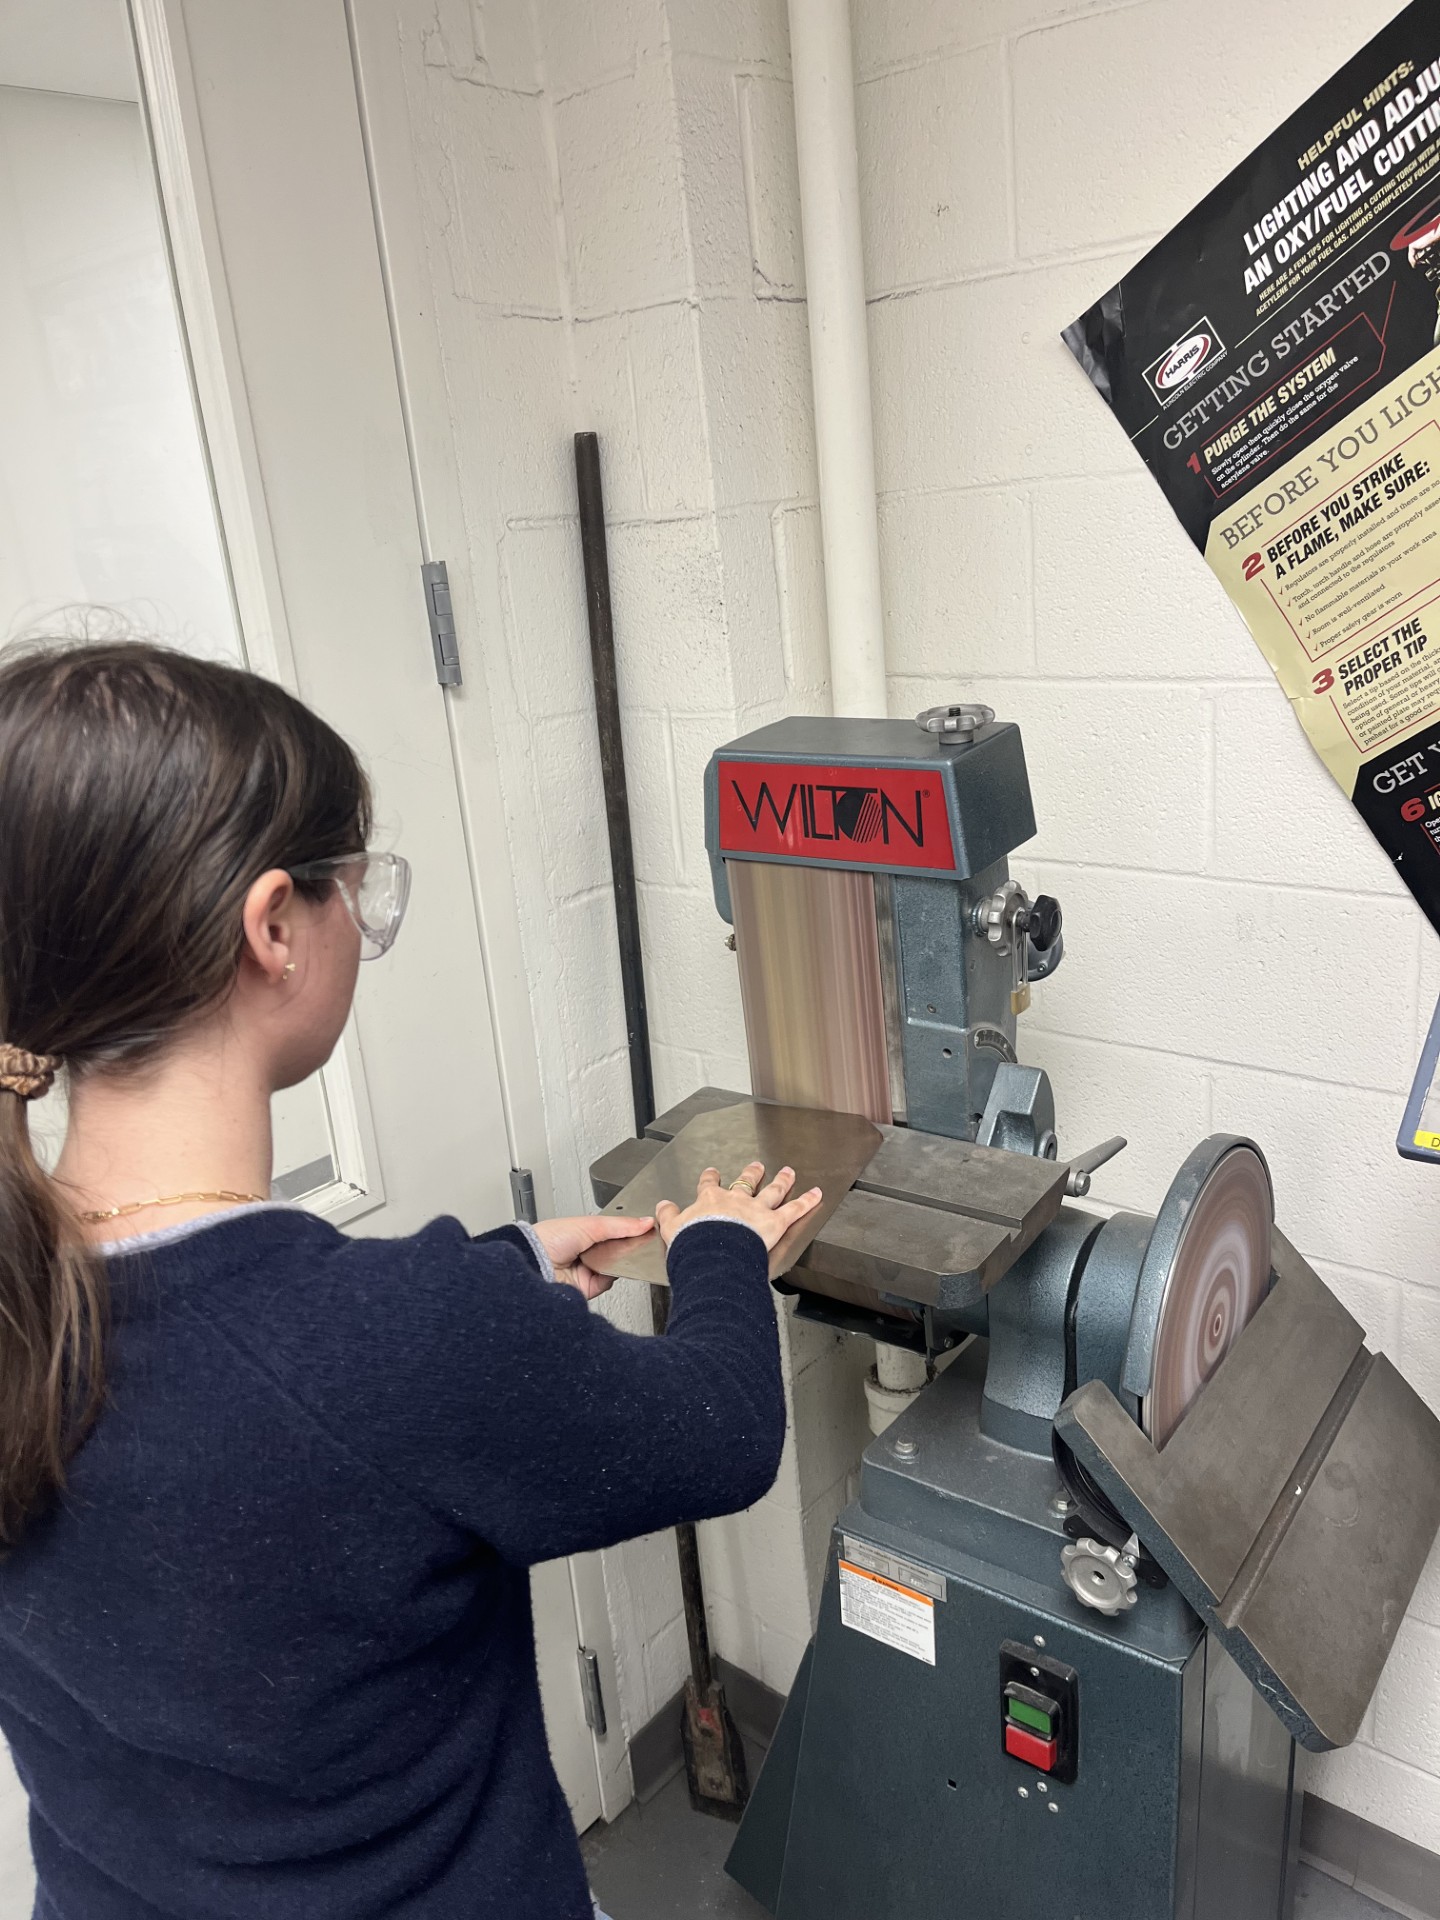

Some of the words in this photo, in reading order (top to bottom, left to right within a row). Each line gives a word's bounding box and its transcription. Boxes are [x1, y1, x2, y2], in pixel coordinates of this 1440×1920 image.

[1297, 108, 1362, 170] HELPFUL
[1362, 60, 1414, 110] HINTS:
[1243, 161, 1335, 255] LIGHTING
[1336, 119, 1380, 174] AND
[1384, 59, 1440, 131] ADJU
[1243, 252, 1273, 294] AN
[1274, 168, 1373, 263] OXY/FUEL
[1256, 283, 1288, 316] ACETYLENE
[1288, 273, 1300, 287] FOR
[1300, 258, 1317, 276] YOUR
[1317, 245, 1334, 262] FUEL
[1333, 233, 1349, 248] GAS.
[1349, 210, 1373, 236] ALWAYS
[1373, 175, 1413, 214] COMPLETELY
[1258, 283, 1275, 301] HERE
[1275, 271, 1288, 287] ARE
[1288, 267, 1294, 276] A
[1293, 254, 1306, 270] FEW
[1306, 242, 1321, 258] TIPS
[1321, 231, 1335, 246] FOR
[1334, 206, 1363, 235] LIGHTING
[1363, 202, 1369, 210] A
[1369, 178, 1396, 205] CUTTING
[1395, 159, 1417, 181] TORCH
[1417, 143, 1435, 163] WITH
[1163, 349, 1269, 449] GETTING
[1271, 251, 1390, 359] STARTED
[1164, 344, 1199, 378] HARRIS
[1165, 388, 1184, 407] LINCOLN
[1183, 369, 1206, 391] ELECTRIC
[1205, 350, 1227, 371] COMPANY
[1203, 418, 1249, 464] PURGE
[1247, 395, 1277, 426] THE
[1277, 346, 1336, 403] SYSTEM
[1211, 456, 1232, 474] Slowly
[1232, 444, 1248, 458] open
[1247, 432, 1262, 446] then
[1262, 413, 1285, 434] quickly
[1285, 400, 1303, 415] close
[1302, 391, 1314, 401] the
[1314, 371, 1339, 392] oxygen
[1338, 356, 1358, 372] valve
[1216, 473, 1225, 481] on
[1224, 465, 1235, 474] the
[1235, 444, 1262, 466] cylinder.
[1261, 430, 1279, 444] Then
[1278, 422, 1288, 431] do
[1287, 414, 1299, 424] the
[1299, 400, 1317, 415] same
[1316, 390, 1327, 401] for
[1326, 382, 1338, 393] the
[1186, 452, 1200, 473] 1
[1219, 465, 1319, 549] BEFORE
[1316, 417, 1378, 472] YOU
[1220, 463, 1250, 488] acetylene
[1249, 449, 1269, 464] valve.
[1266, 514, 1320, 563] BEFORE
[1319, 492, 1350, 522] YOU
[1352, 452, 1405, 500] STRIKE
[1275, 562, 1286, 579] A
[1286, 526, 1339, 570] FLAME,
[1338, 491, 1382, 532] MAKE
[1384, 460, 1430, 500] SURE:
[1284, 565, 1318, 590] Regulators
[1318, 558, 1329, 567] are
[1328, 538, 1356, 561] properly
[1356, 516, 1386, 540] installed
[1386, 506, 1399, 520] and
[1399, 495, 1418, 510] there
[1418, 486, 1430, 496] are
[1242, 552, 1264, 581] 2
[1292, 588, 1313, 602] Torch,
[1312, 575, 1330, 588] torch
[1328, 560, 1352, 577] handle
[1352, 549, 1365, 561] and
[1364, 539, 1381, 552] hose
[1381, 531, 1393, 541] are
[1393, 509, 1423, 534] properly
[1297, 597, 1310, 609] and
[1310, 575, 1343, 600] connected
[1349, 563, 1361, 572] the
[1361, 540, 1395, 566] regulators
[1304, 613, 1315, 622] No
[1314, 590, 1348, 615] flammable
[1348, 570, 1378, 592] materials
[1386, 553, 1402, 568] your
[1402, 541, 1420, 555] work
[1421, 531, 1437, 543] area
[1311, 621, 1331, 634] Room
[1337, 583, 1385, 618] well-ventilated
[1319, 630, 1341, 647] Proper
[1341, 618, 1360, 633] safety
[1361, 607, 1377, 621] gear
[1384, 591, 1403, 605] worn
[1338, 636, 1389, 679] SELECT
[1391, 616, 1422, 645] THE
[1344, 650, 1402, 696] PROPER
[1403, 634, 1427, 658] TIP
[1312, 668, 1334, 694] 3
[1342, 694, 1363, 709] Select
[1368, 685, 1378, 693] tip
[1377, 671, 1400, 688] based
[1400, 666, 1410, 674] on
[1409, 659, 1421, 668] the
[1347, 696, 1377, 716] condition
[1377, 689, 1385, 697] of
[1385, 681, 1401, 694] your
[1401, 663, 1432, 684] material,
[1349, 709, 1370, 723] being
[1370, 698, 1389, 711] used.
[1388, 686, 1409, 700] Some
[1408, 678, 1422, 688] tips
[1422, 669, 1436, 680] will
[1354, 716, 1376, 730] option
[1375, 709, 1383, 718] of
[1383, 694, 1410, 714] general
[1418, 677, 1440, 693] heavy
[1363, 727, 1389, 746] preheat
[1388, 721, 1398, 730] for
[1404, 706, 1422, 722] good
[1422, 700, 1436, 710] cut.
[1366, 714, 1392, 734] painted
[1392, 705, 1410, 719] plate
[1410, 695, 1425, 708] may
[1373, 751, 1427, 793] GET
[731, 780, 924, 847] WILTON
[1401, 797, 1425, 821] 6
